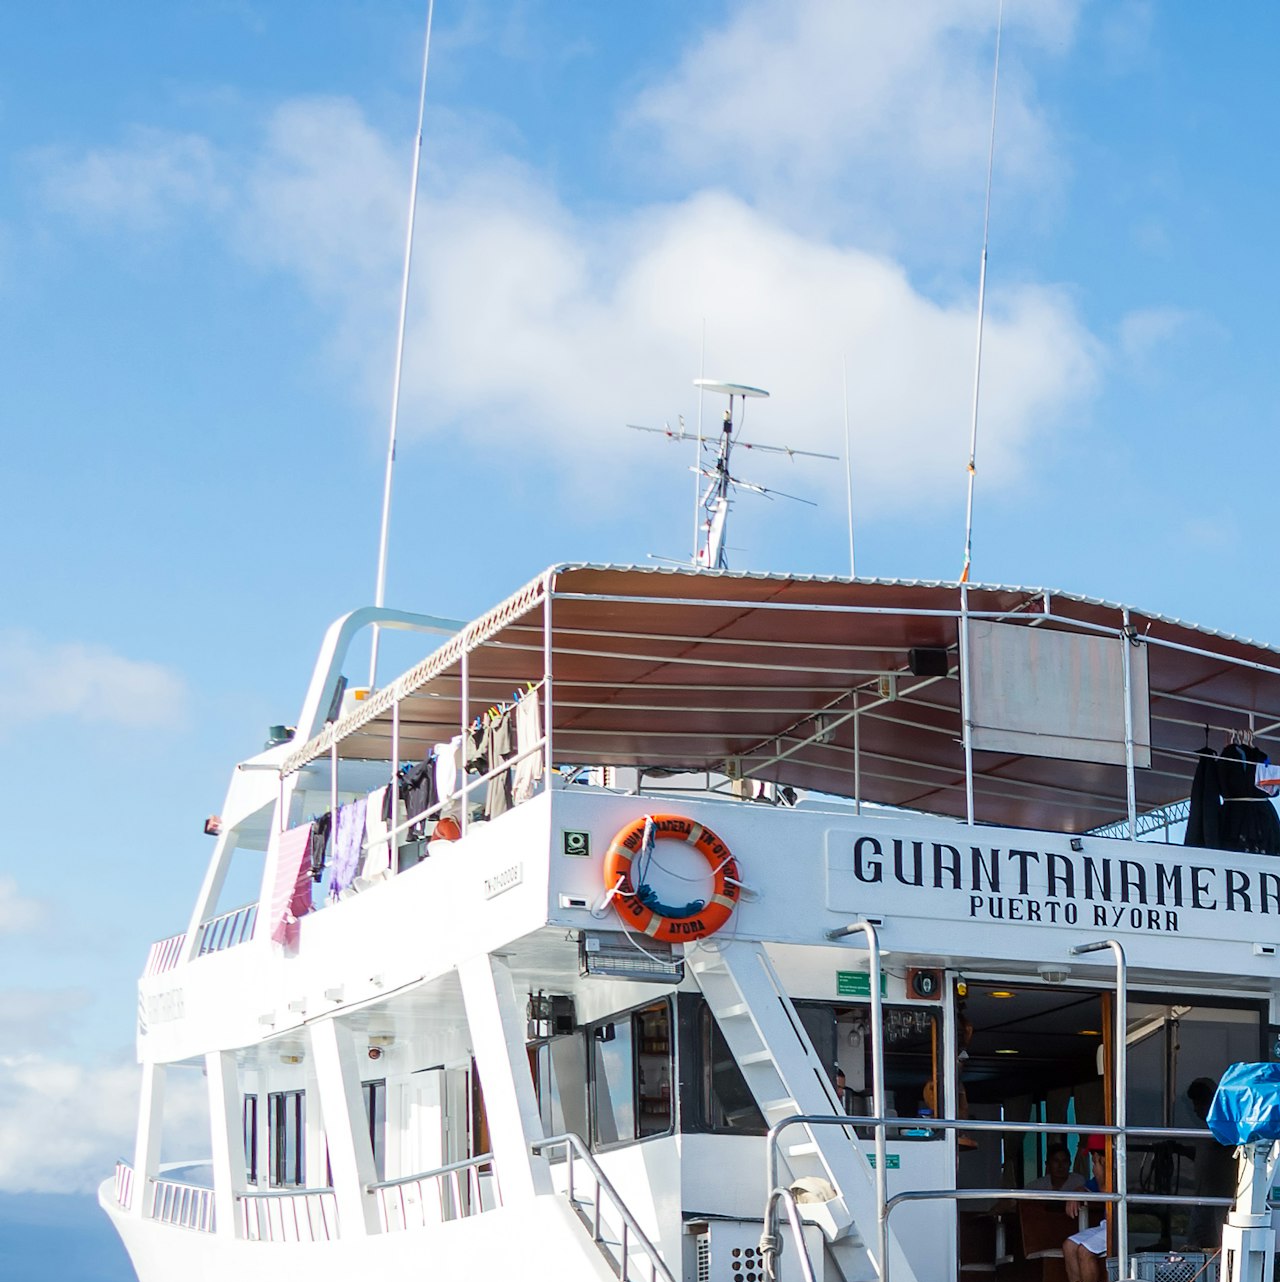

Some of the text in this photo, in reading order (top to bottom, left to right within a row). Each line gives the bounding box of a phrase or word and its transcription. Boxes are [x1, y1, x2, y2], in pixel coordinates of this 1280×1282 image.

[669, 919, 705, 934] AYORA
[970, 895, 1179, 932] PUERTO AYORA
